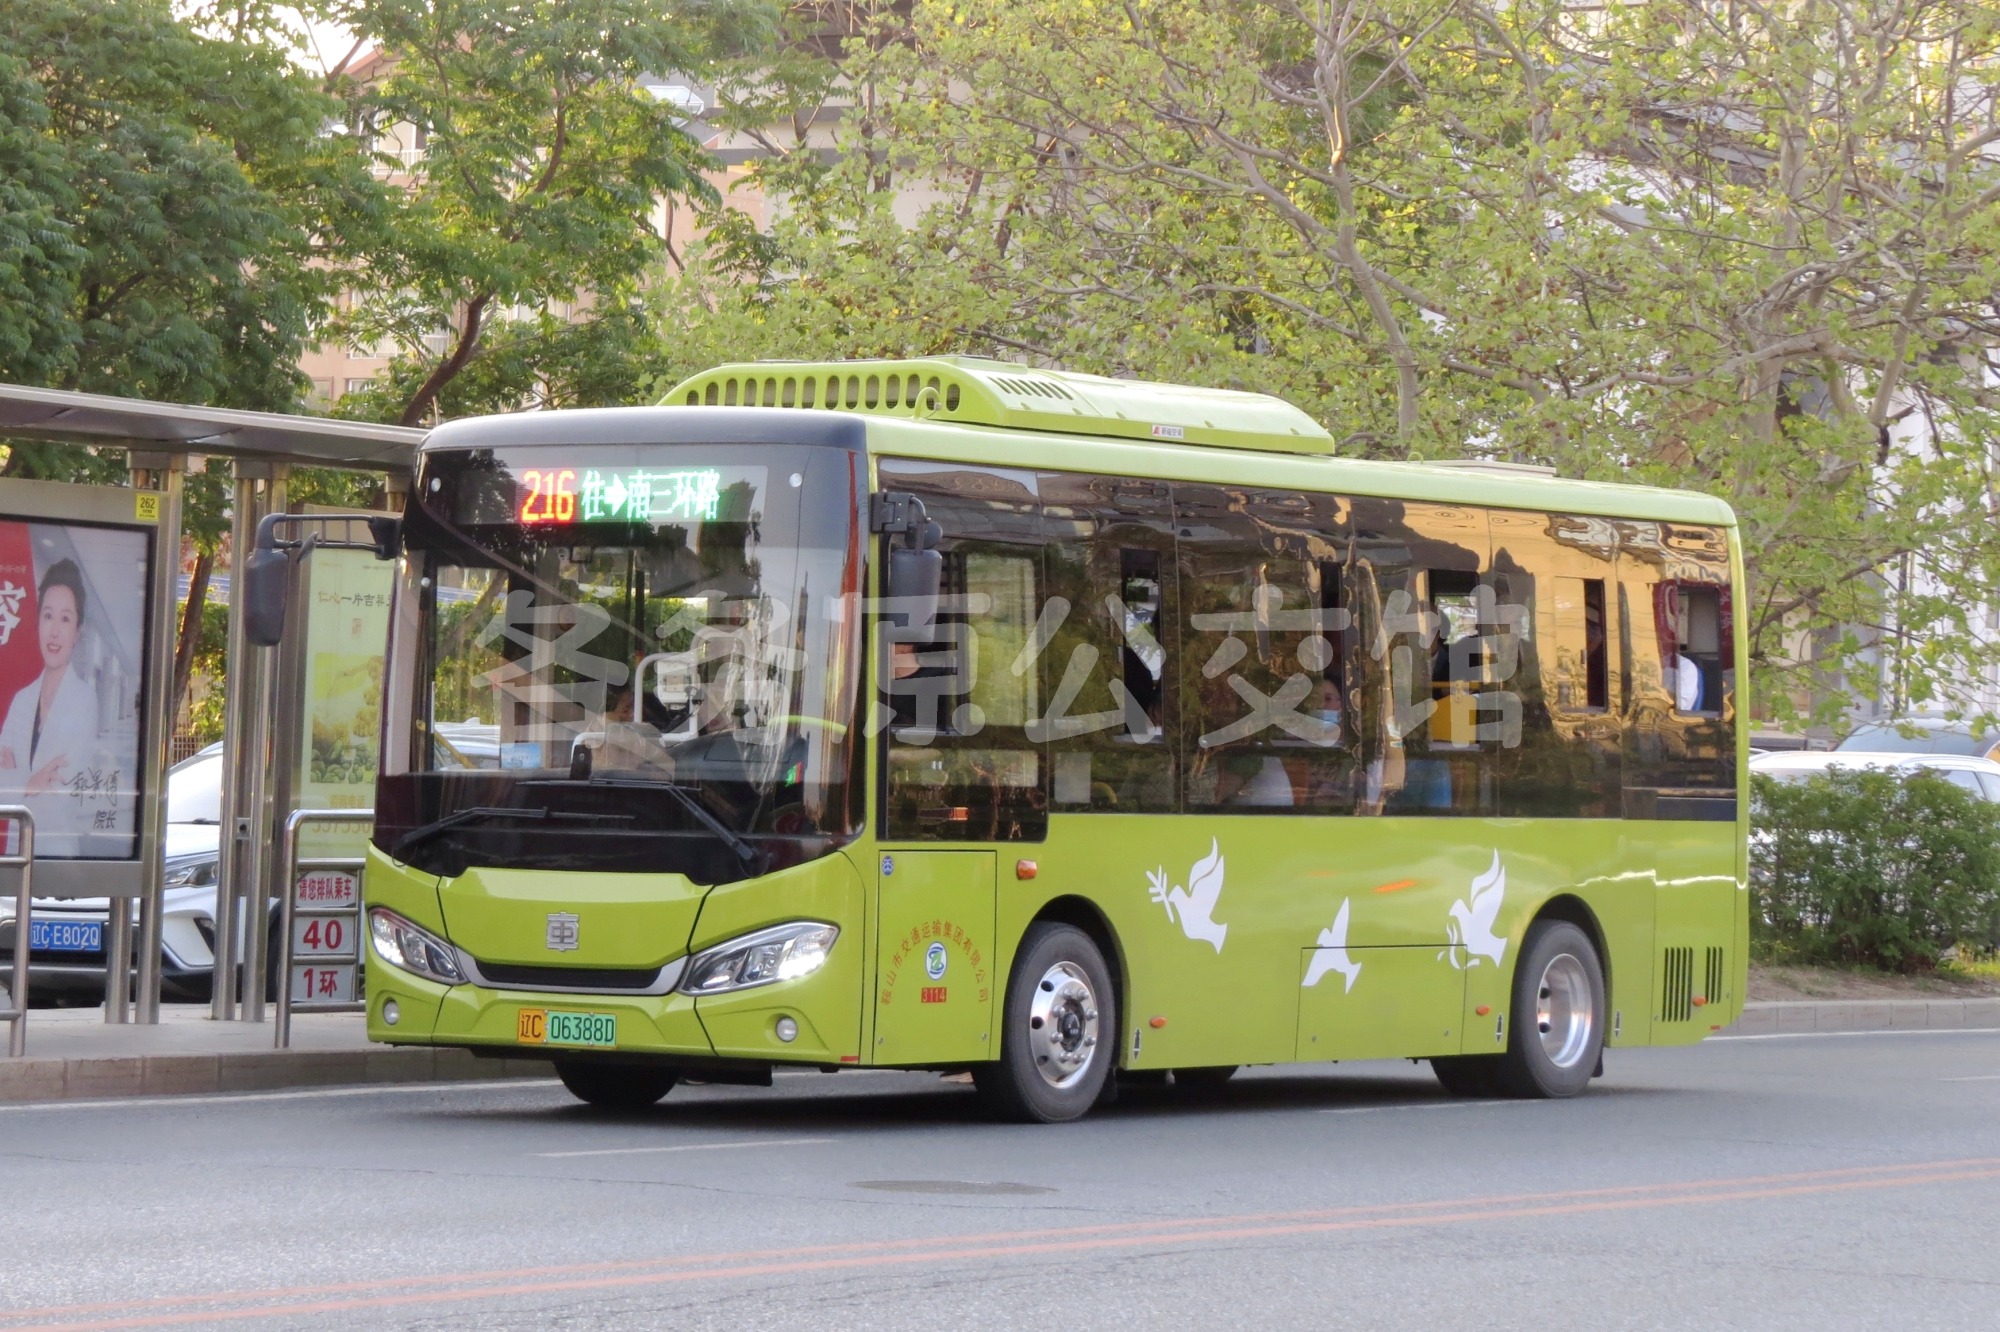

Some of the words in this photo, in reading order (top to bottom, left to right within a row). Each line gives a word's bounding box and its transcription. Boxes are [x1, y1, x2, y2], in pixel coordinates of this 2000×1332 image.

[140, 497, 156, 509] 262
[521, 470, 575, 522] 216
[627, 468, 720, 519] 南三环路
[93, 810, 117, 830] 院长
[299, 877, 352, 901] 请您排队乘车
[303, 919, 342, 949] 40
[881, 918, 988, 1005] 鞍山市交通运输集团有限公司
[922, 987, 945, 1002] 3114
